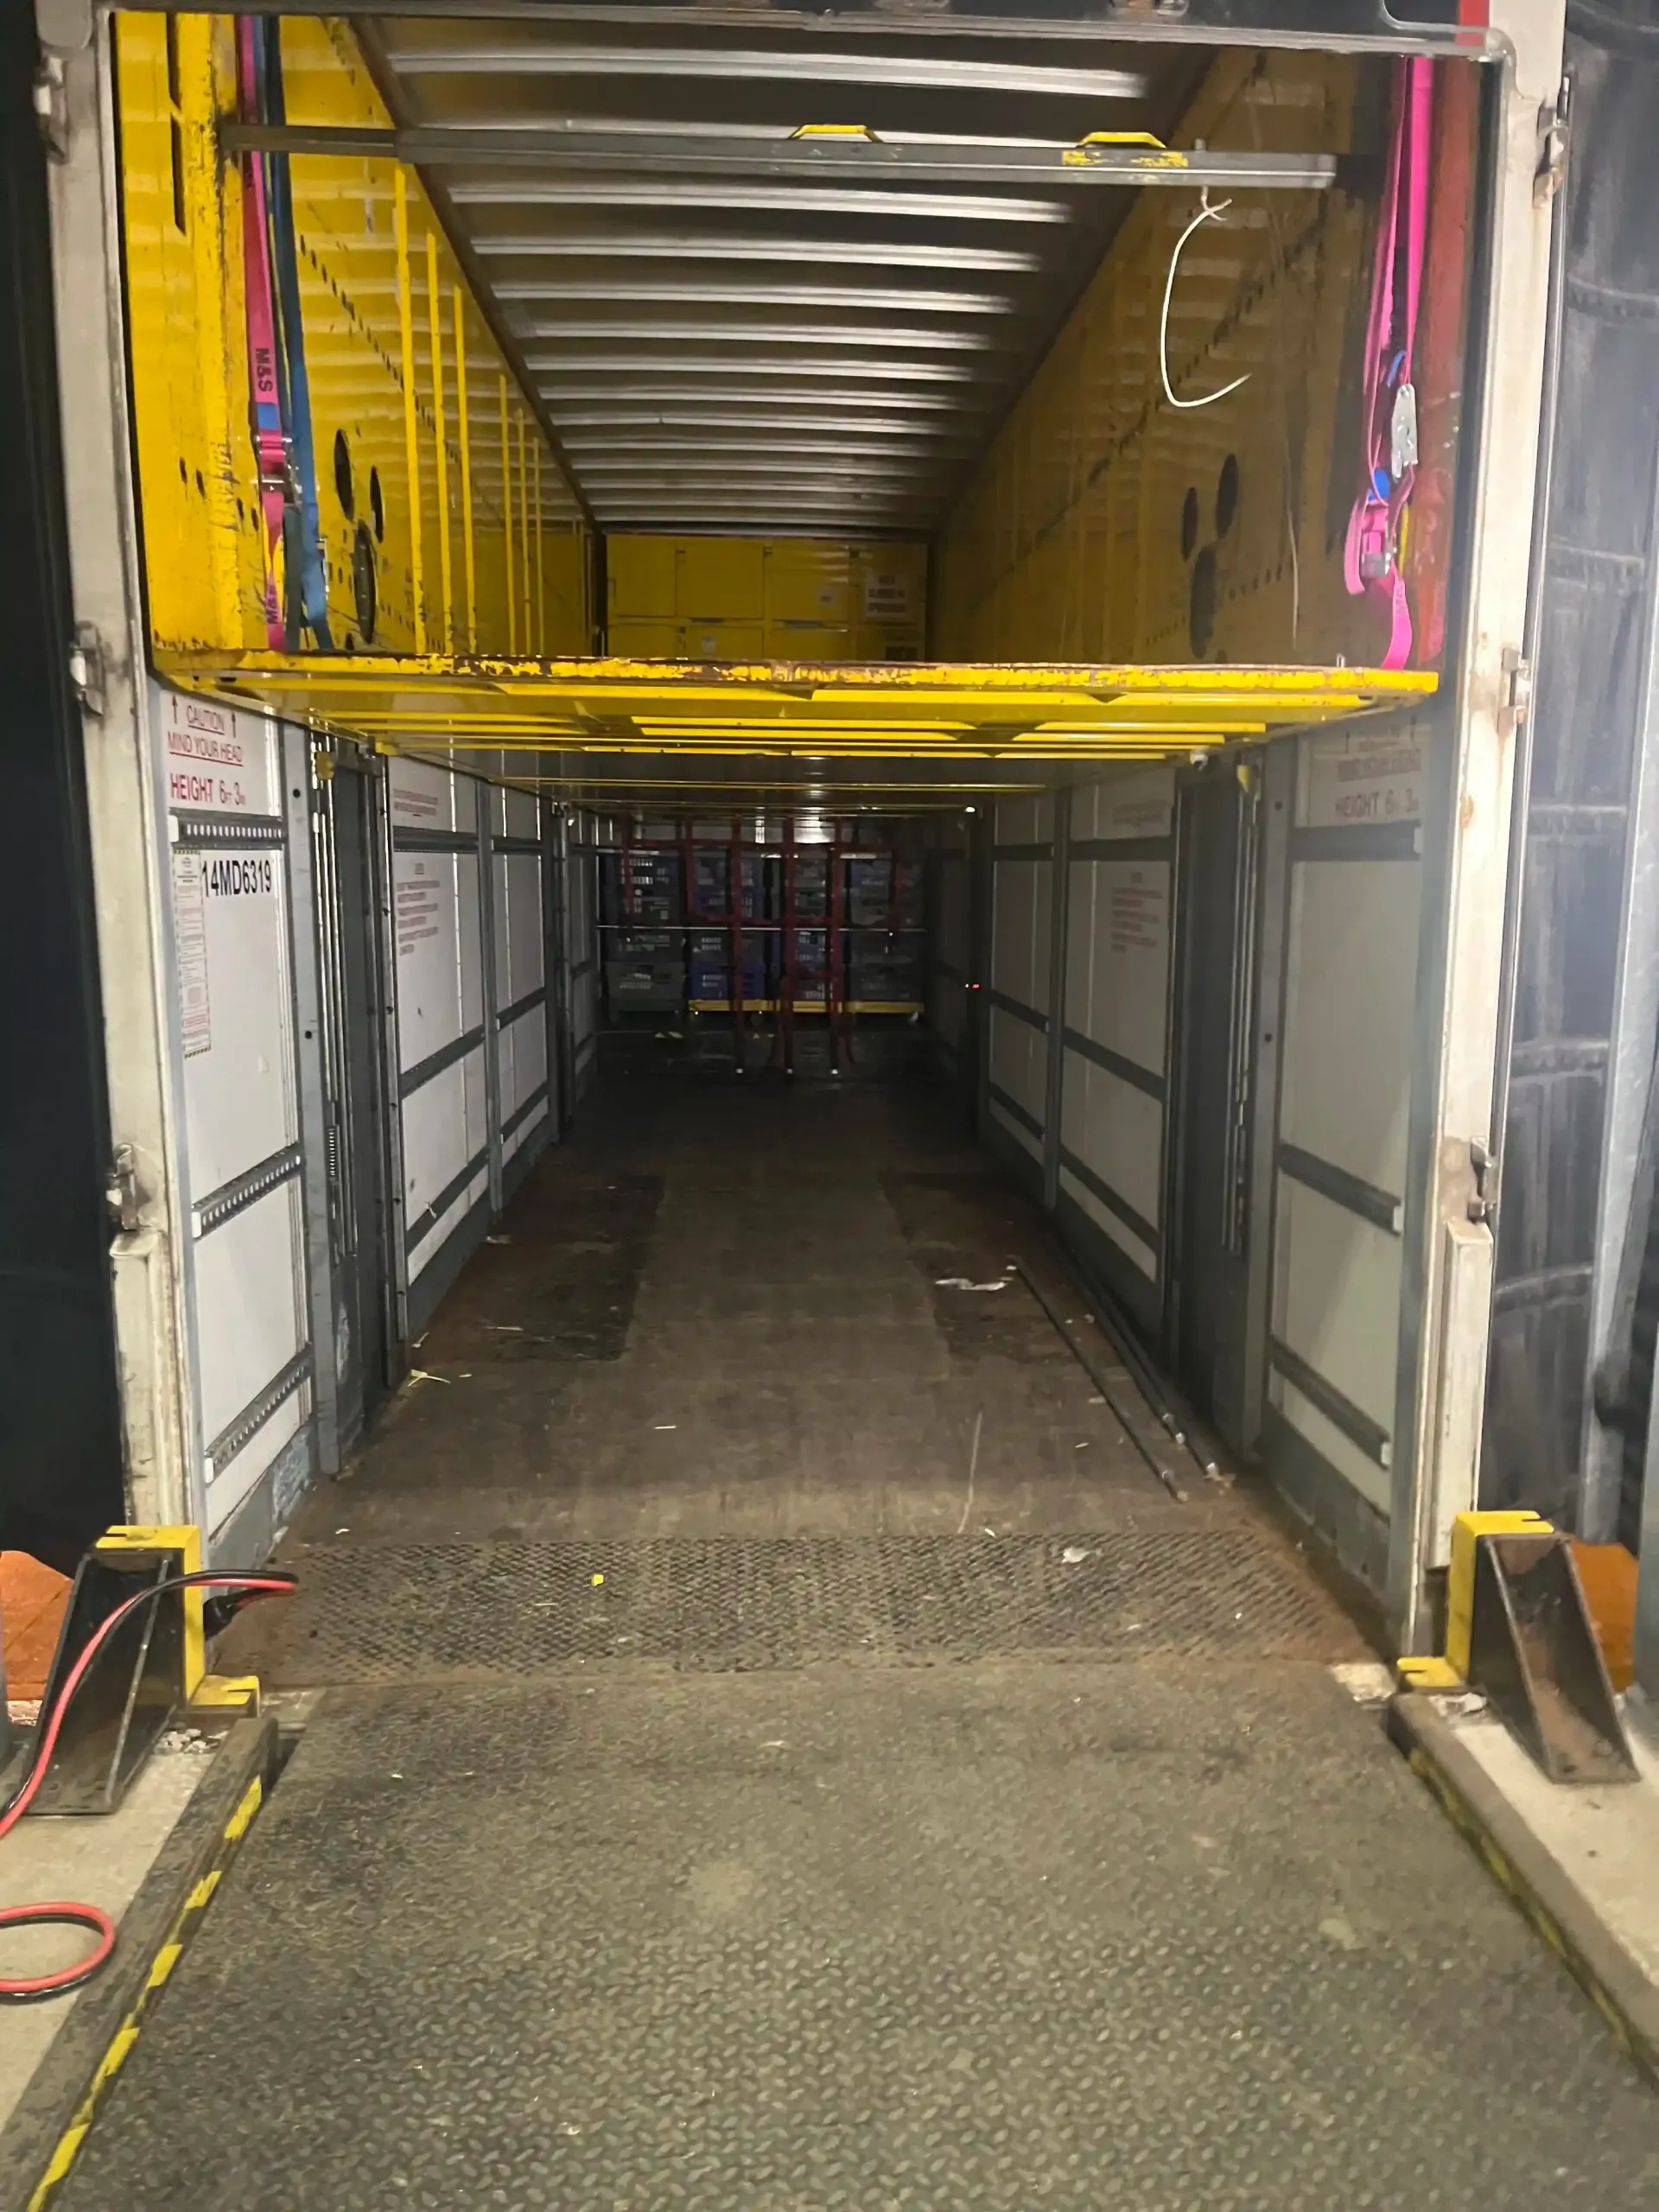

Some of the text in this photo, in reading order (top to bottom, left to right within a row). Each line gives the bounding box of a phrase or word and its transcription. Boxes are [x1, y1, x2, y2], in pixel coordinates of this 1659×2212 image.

[256, 347, 273, 391] M&S
[187, 705, 225, 731] CAUTION
[168, 730, 243, 762] MIND YOUR HEAD
[170, 772, 213, 802] HEIGHT
[202, 859, 271, 897] 14MD6319
